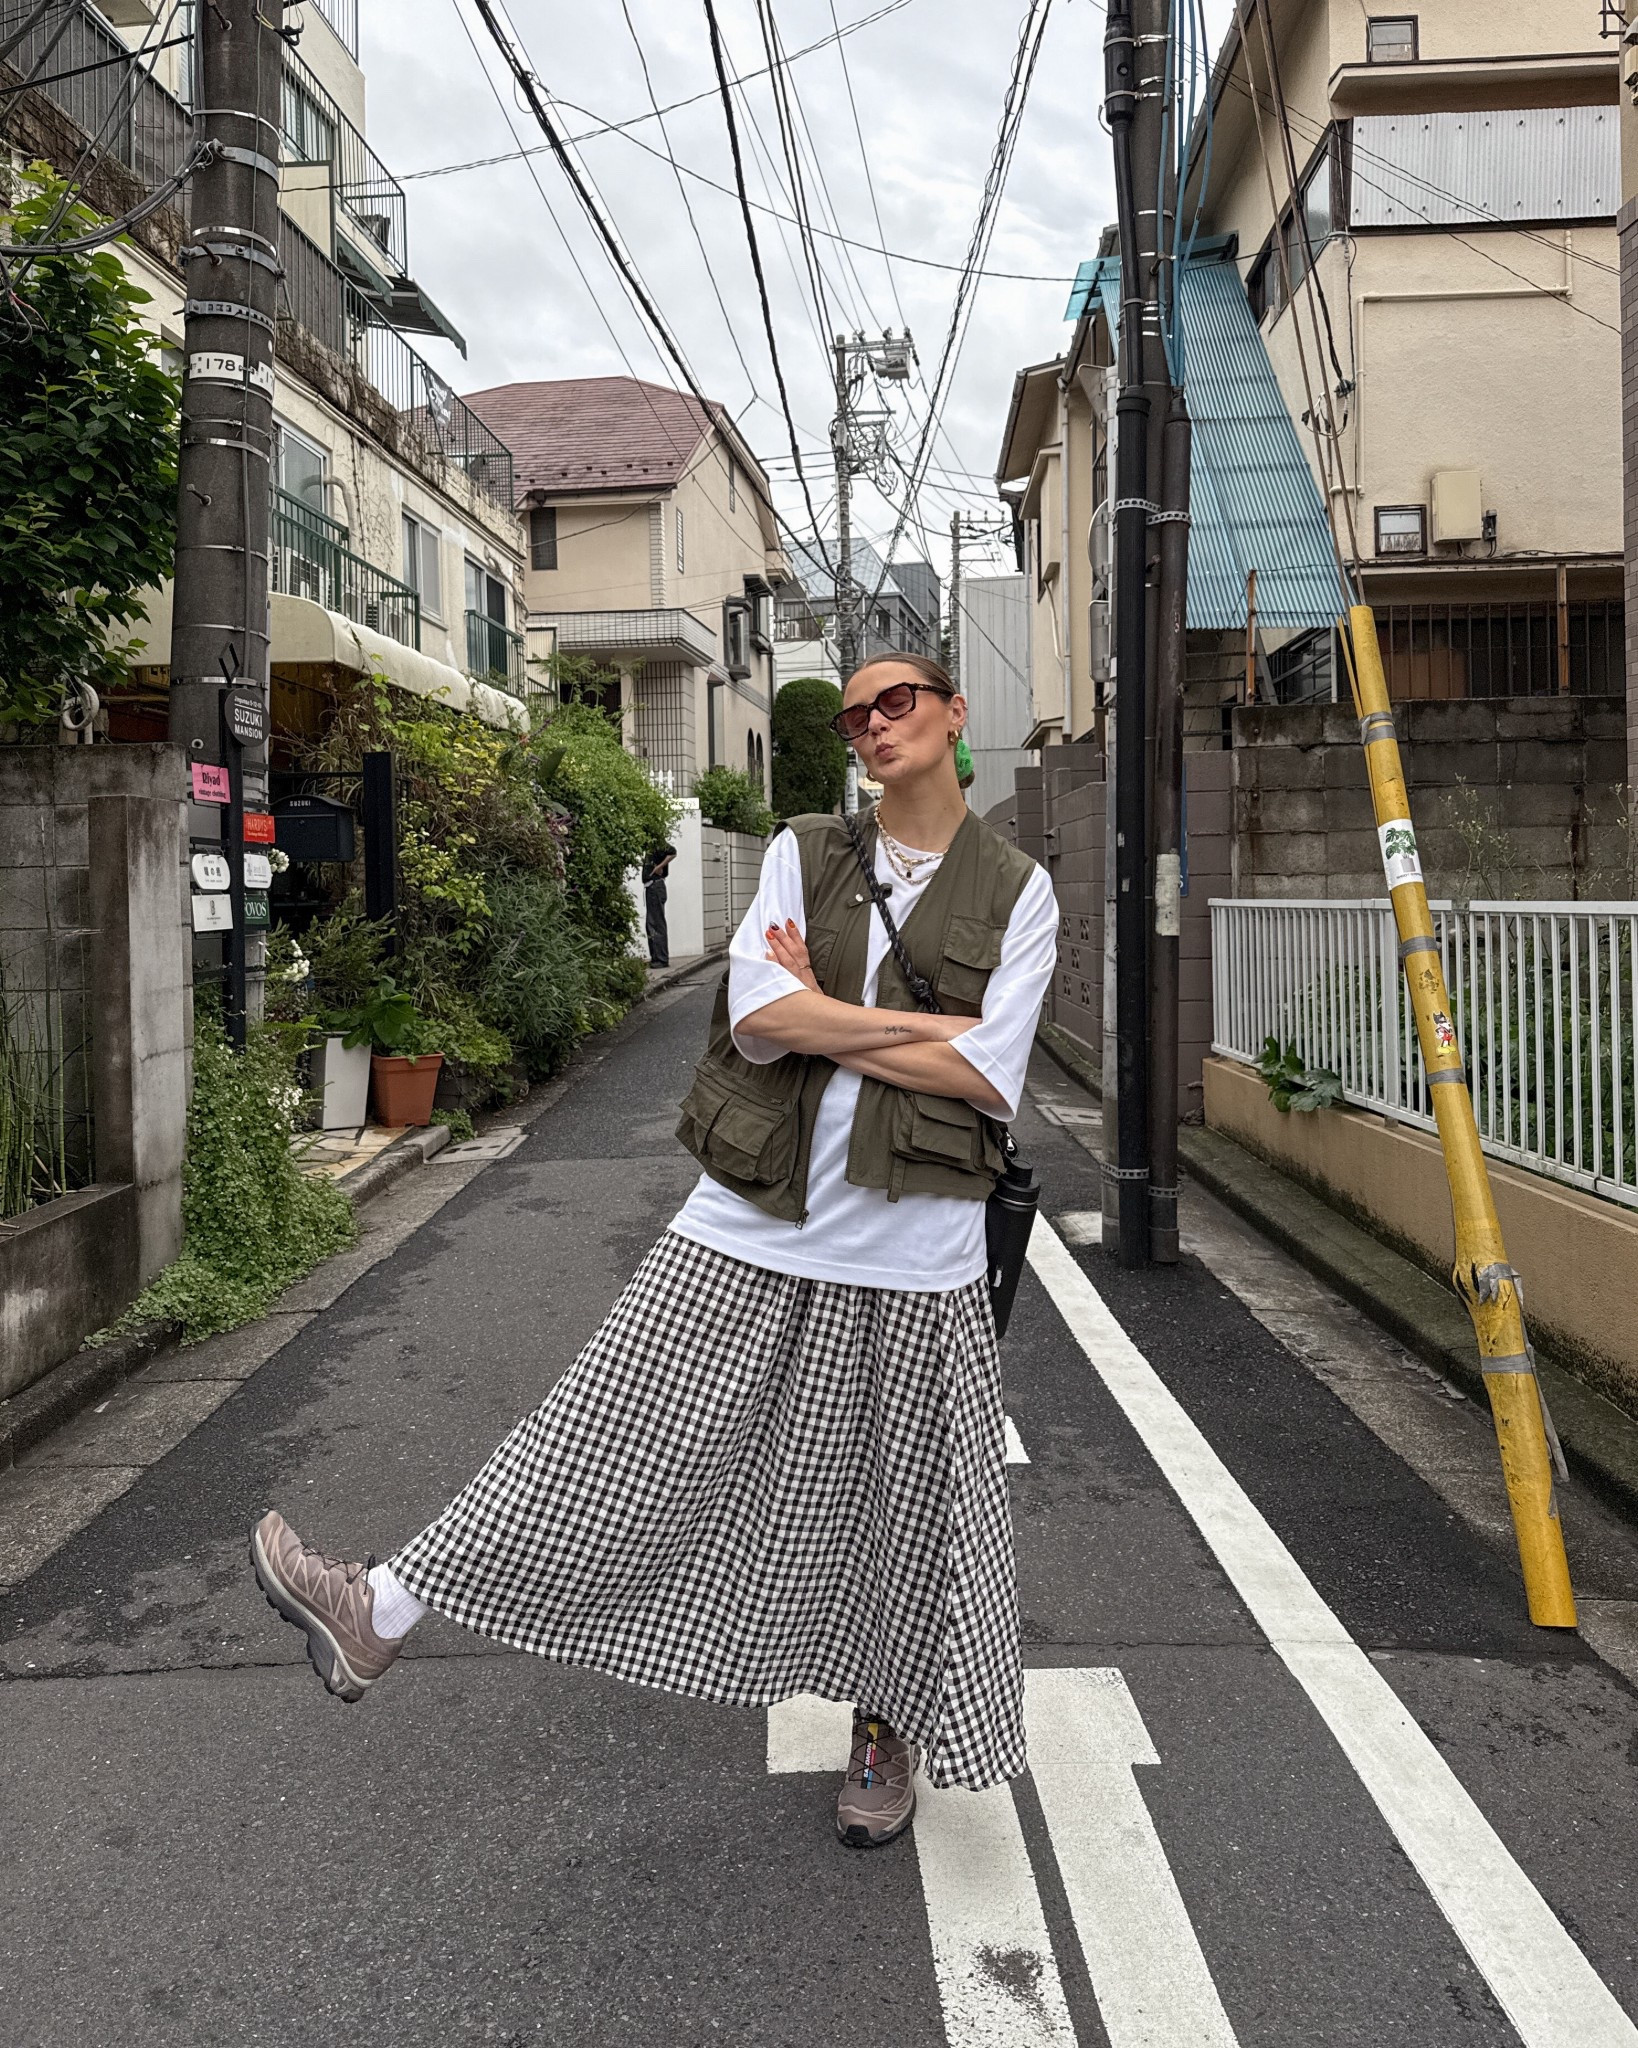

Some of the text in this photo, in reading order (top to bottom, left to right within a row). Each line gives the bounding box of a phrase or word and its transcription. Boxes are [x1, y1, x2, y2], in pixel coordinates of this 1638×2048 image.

[206, 357, 235, 371] 178
[234, 708, 262, 727] SUZUKI
[234, 723, 262, 740] MANSION
[202, 772, 220, 787] Riyad
[245, 901, 267, 917] OVOS
[863, 1742, 873, 1778] SAOMON
